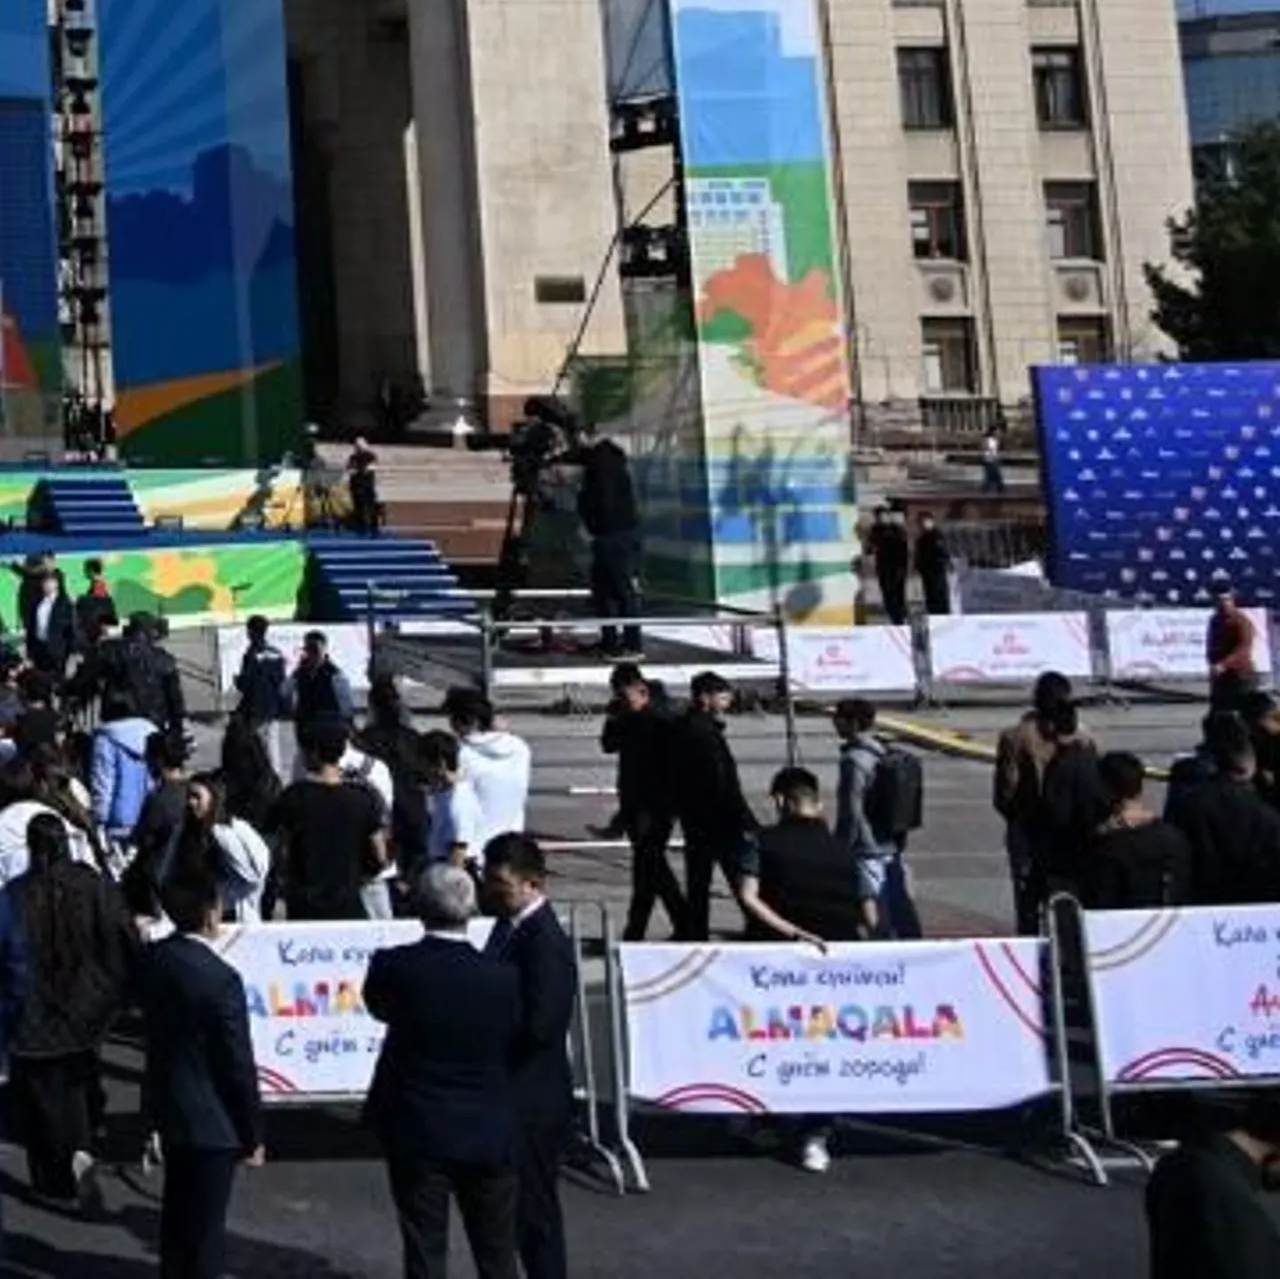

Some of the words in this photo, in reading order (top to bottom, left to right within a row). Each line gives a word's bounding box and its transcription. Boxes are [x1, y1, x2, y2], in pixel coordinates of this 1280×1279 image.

[246, 980, 364, 1017] ALMA
[707, 1004, 965, 1042] ALMAQALA
[275, 1030, 295, 1056] С
[1216, 1025, 1236, 1052] С
[747, 1054, 766, 1077] С
